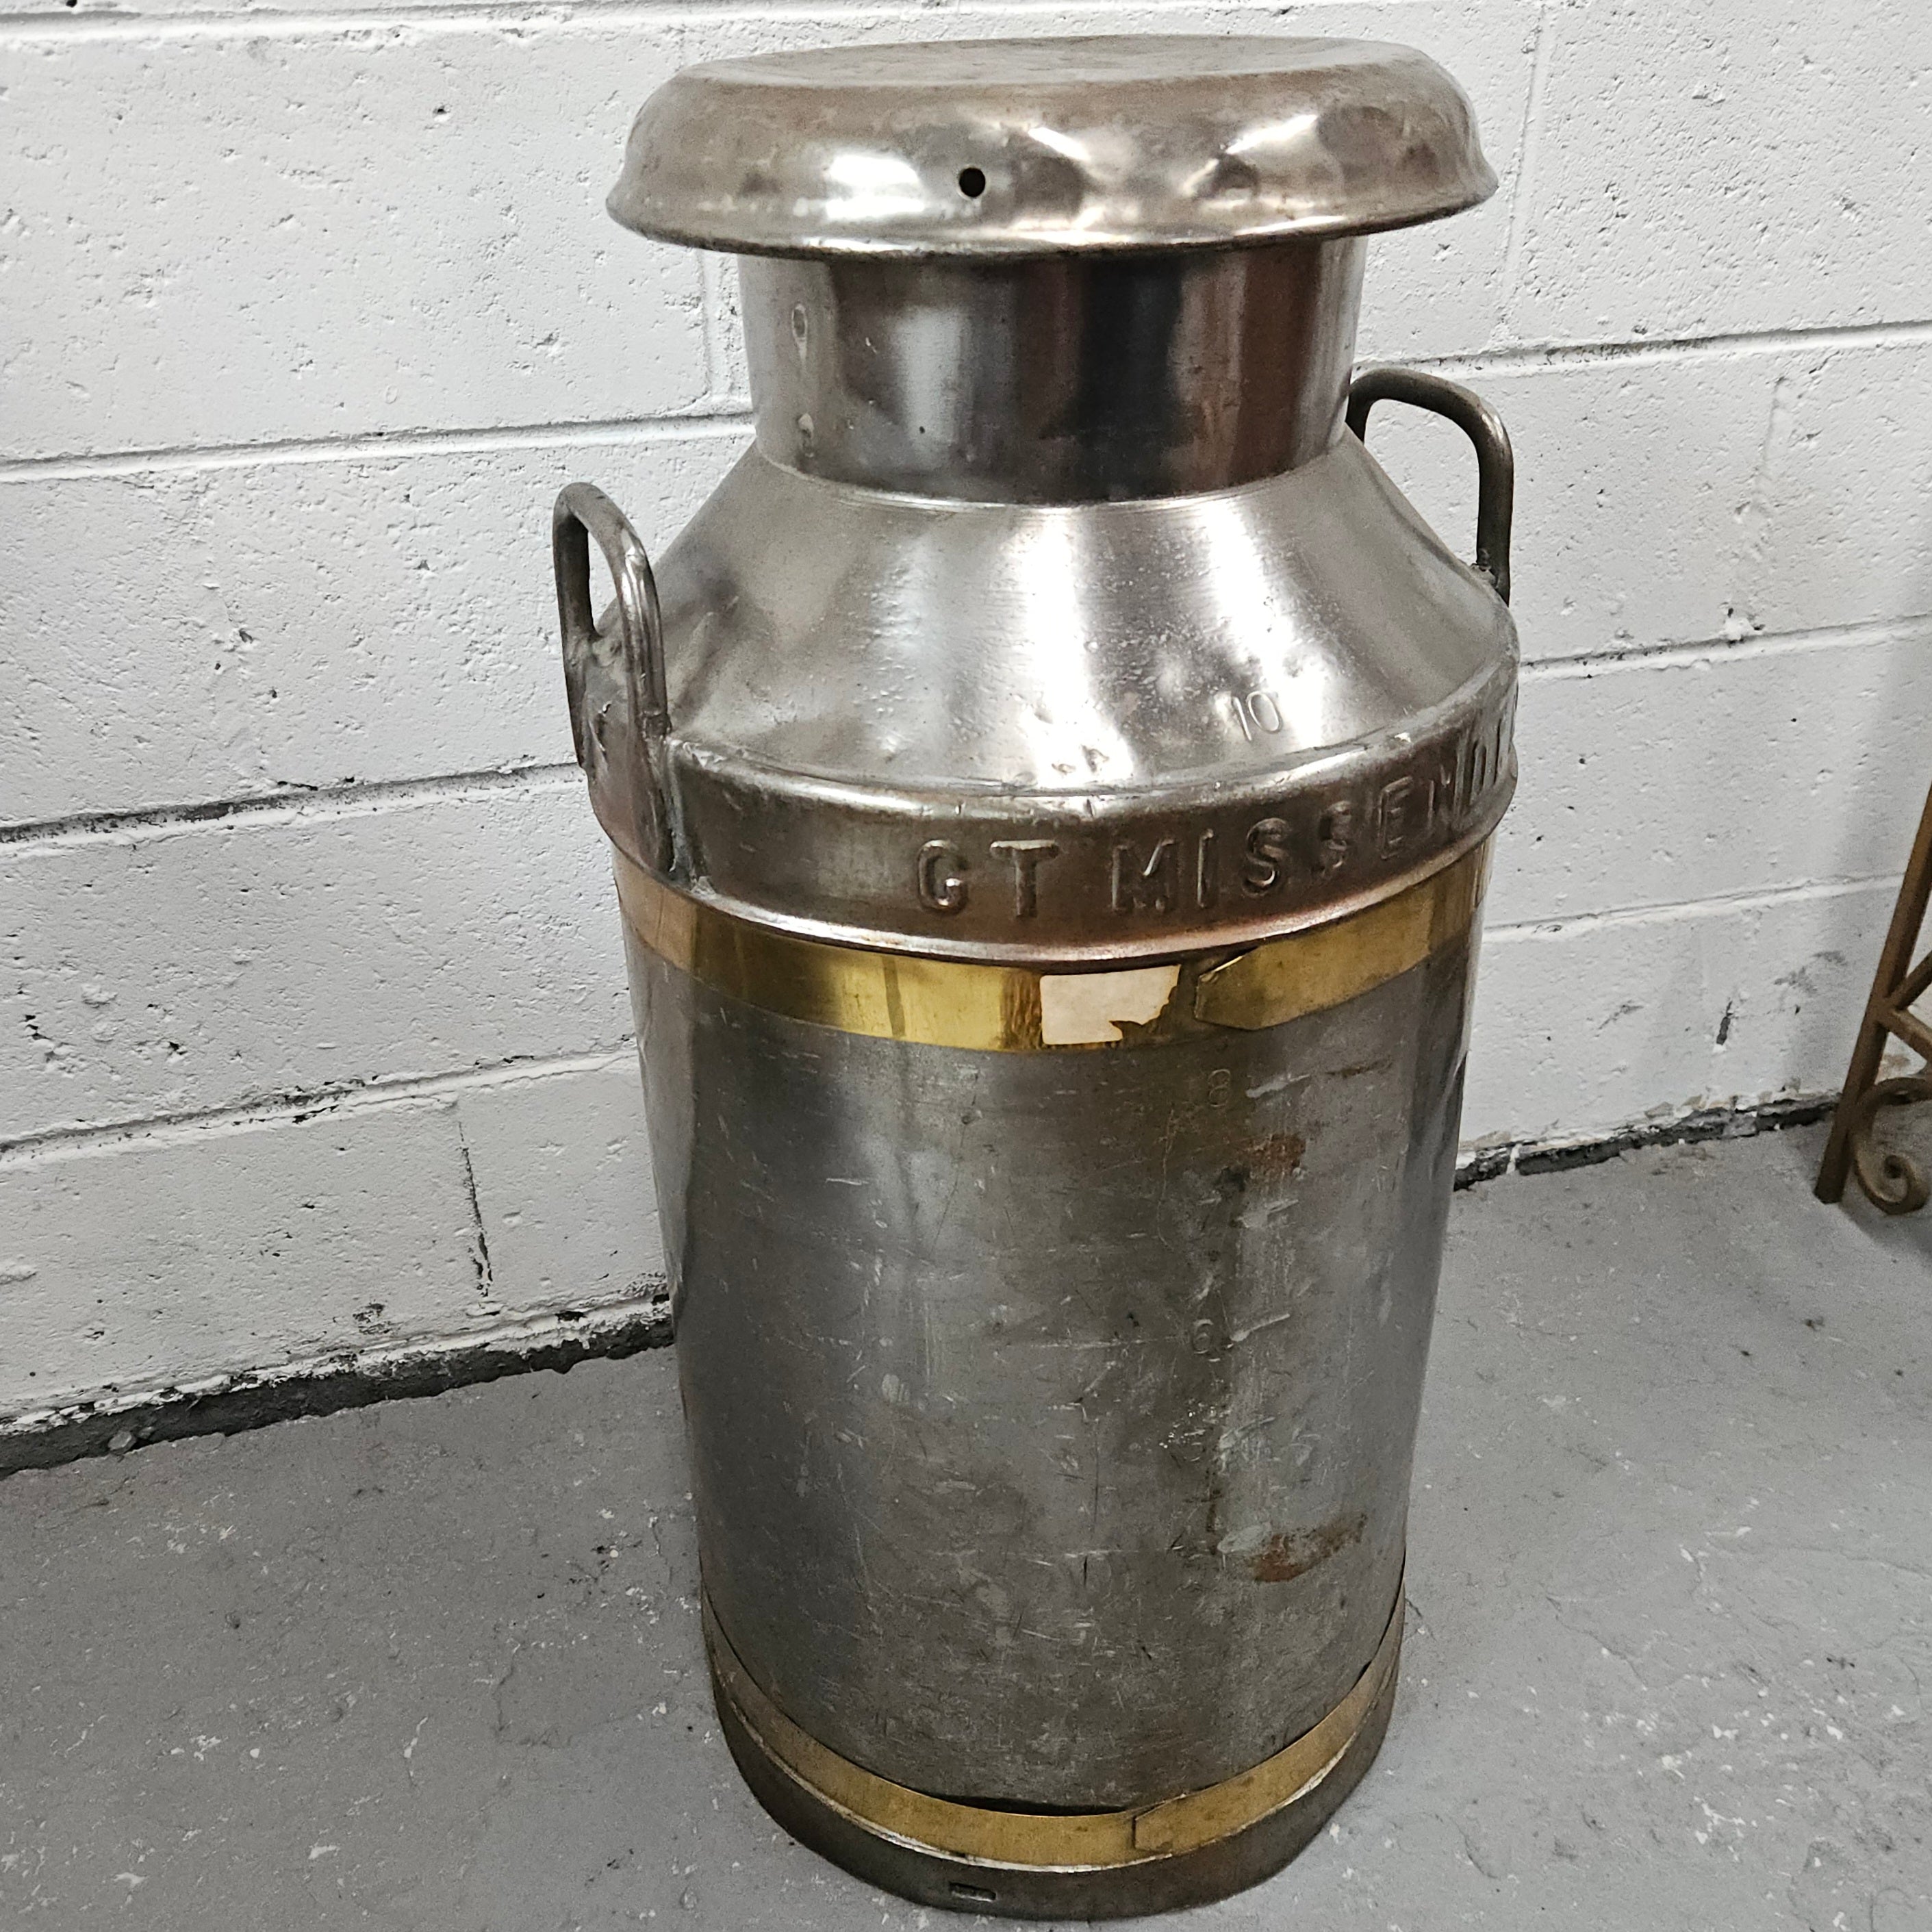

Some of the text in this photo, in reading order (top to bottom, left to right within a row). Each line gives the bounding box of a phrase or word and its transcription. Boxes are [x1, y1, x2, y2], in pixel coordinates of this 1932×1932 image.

[1232, 690, 1284, 742] 10
[915, 837, 1060, 919] GT
[1207, 1068, 1231, 1108] 8
